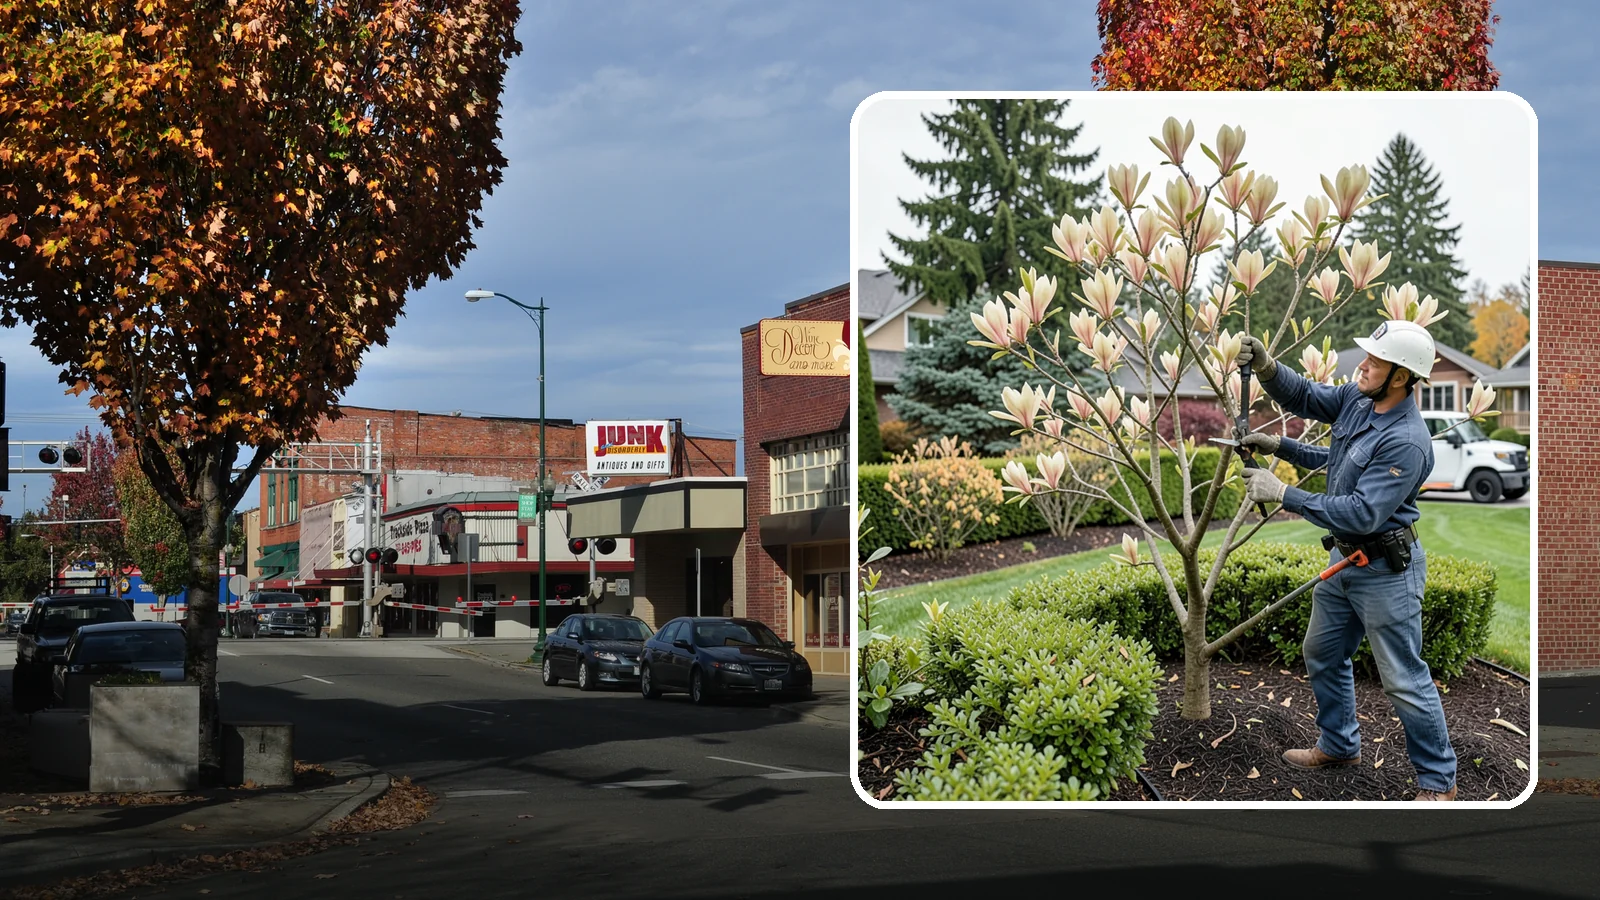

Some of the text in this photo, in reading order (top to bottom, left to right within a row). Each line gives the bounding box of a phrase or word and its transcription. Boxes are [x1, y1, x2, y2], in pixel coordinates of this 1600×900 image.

[596, 425, 665, 457] JUNK
[607, 446, 645, 454] DISORDERLY
[597, 461, 665, 469] ANTIQUES AND GIFTS
[390, 521, 413, 540] Trackside
[415, 520, 429, 535] Pizza
